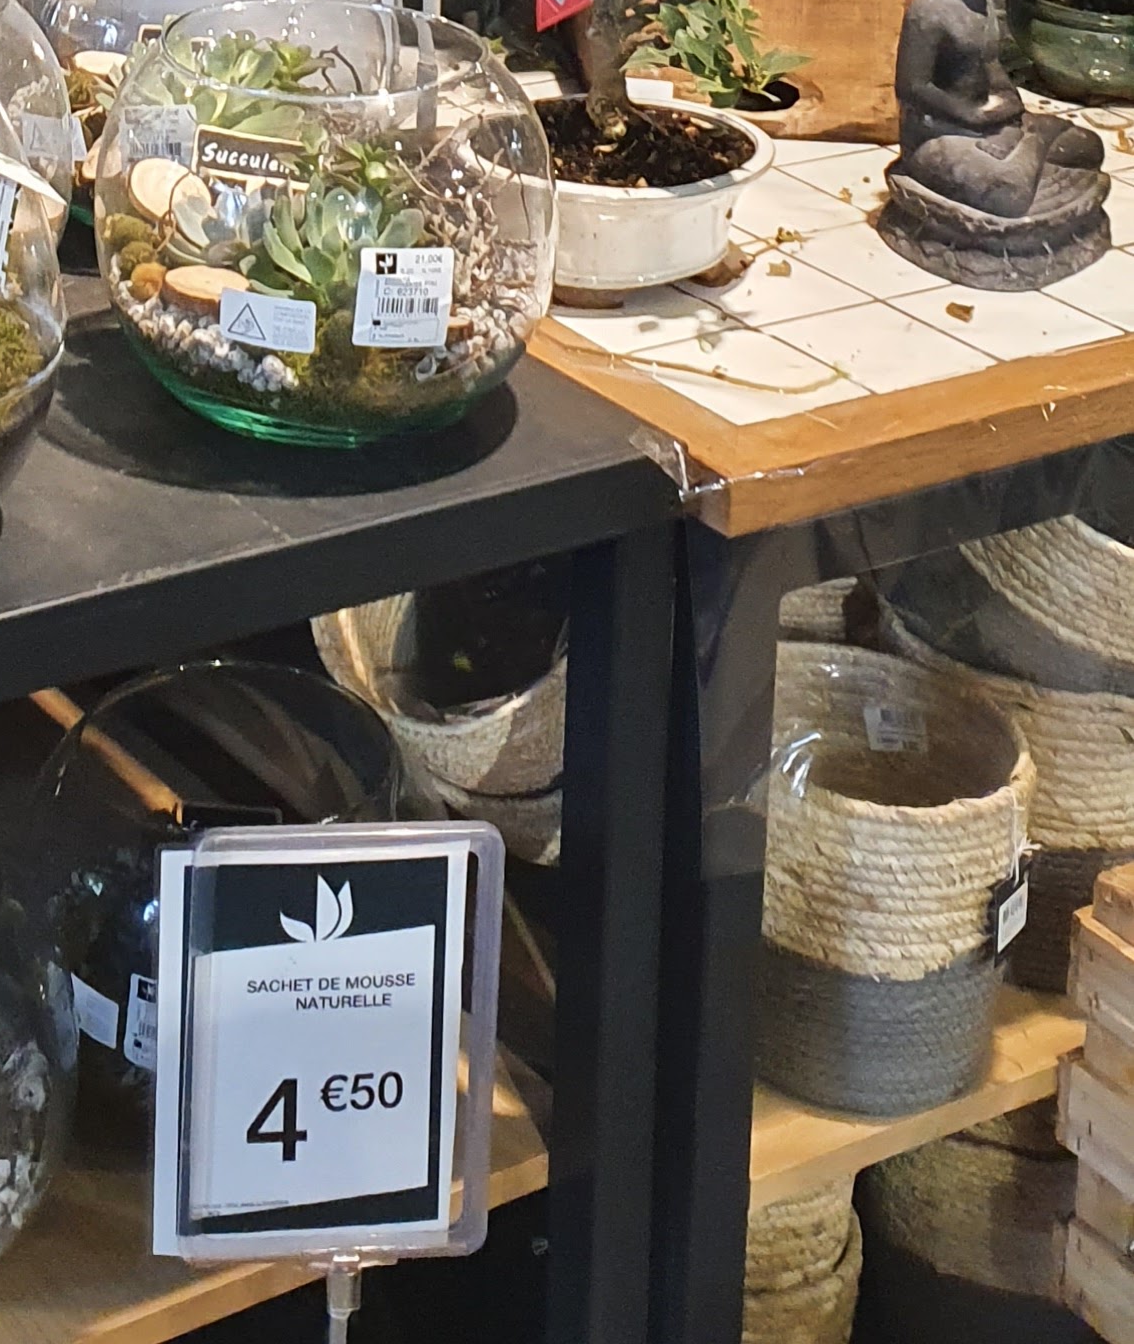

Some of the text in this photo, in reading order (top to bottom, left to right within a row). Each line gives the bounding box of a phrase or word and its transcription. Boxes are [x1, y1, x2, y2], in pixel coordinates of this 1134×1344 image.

[247, 973, 416, 994] SACHET DE MOUSSE
[295, 993, 393, 1011] NATURELLE
[246, 1070, 404, 1162] 4 €50
